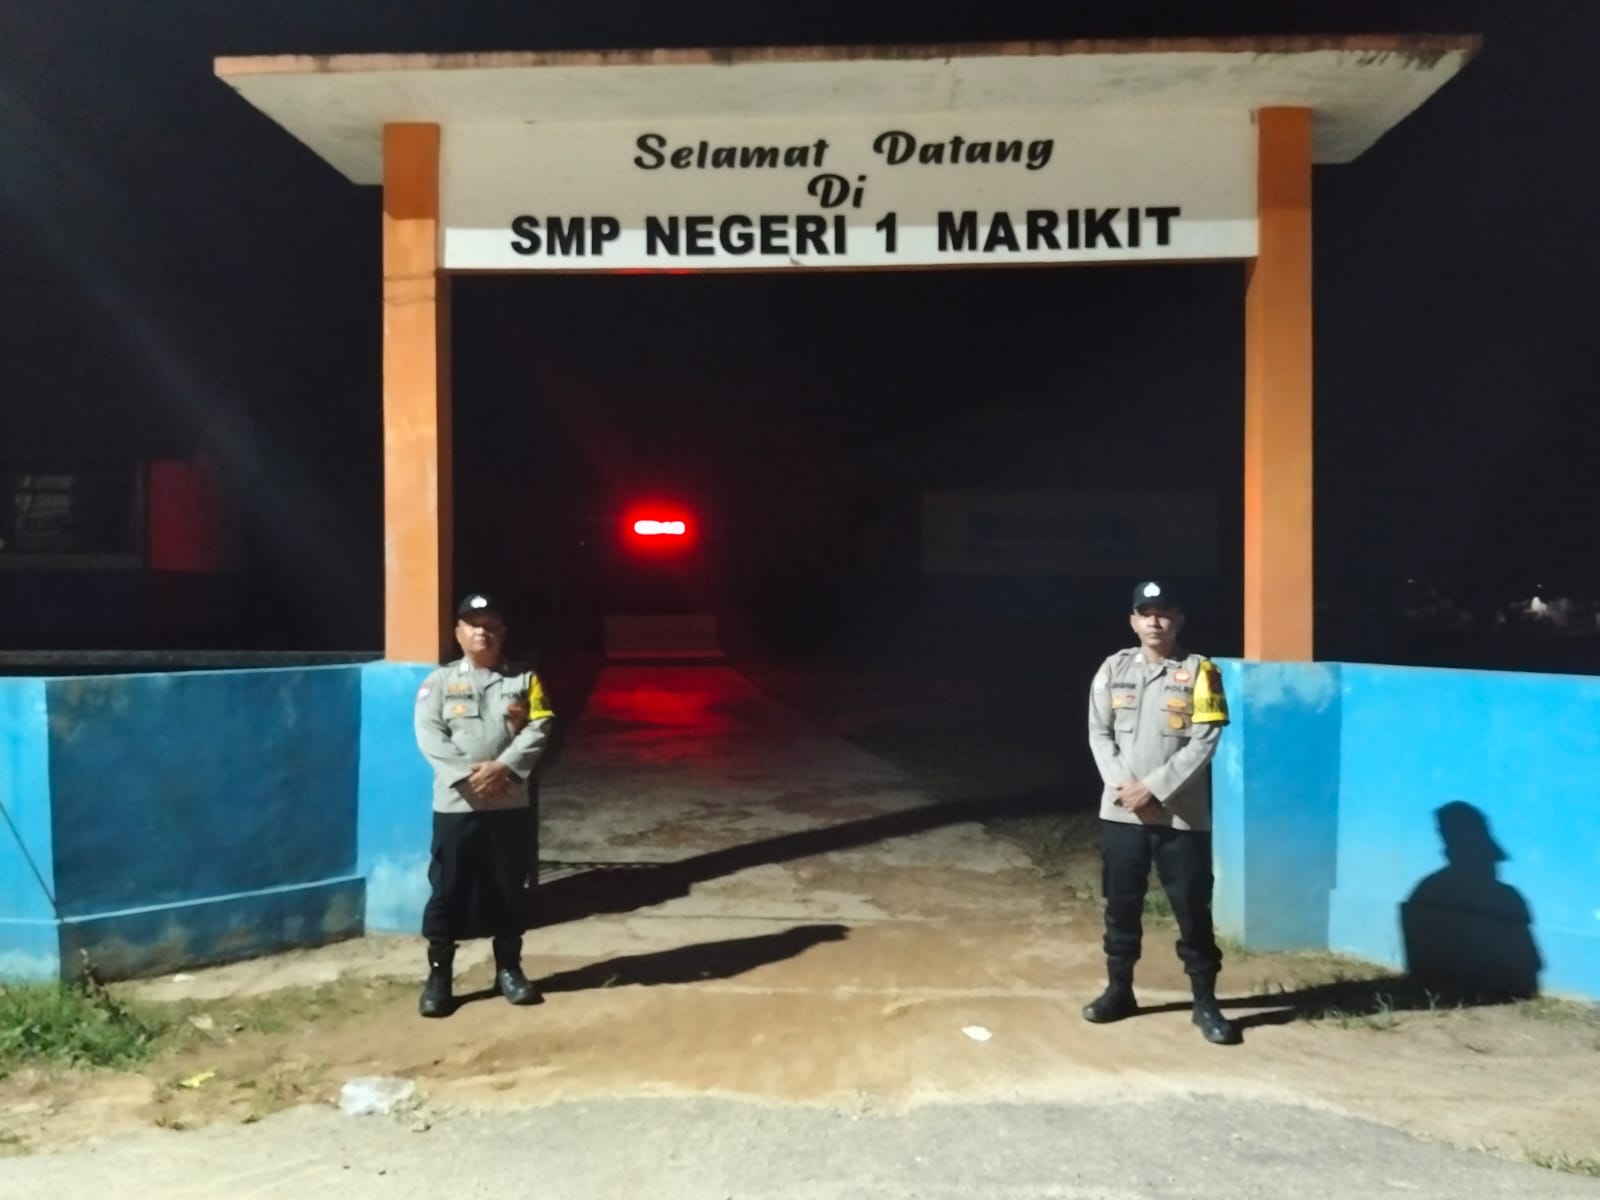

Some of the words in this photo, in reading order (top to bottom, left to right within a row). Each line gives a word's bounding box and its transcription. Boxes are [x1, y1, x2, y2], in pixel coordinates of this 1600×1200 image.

[634, 133, 829, 170] Selamat
[873, 130, 1054, 171] Datang
[808, 173, 867, 209] Di
[511, 215, 620, 256] SMP
[645, 213, 846, 255] NEGERI
[875, 211, 897, 253] 1
[937, 207, 1181, 252] MARIKIT
